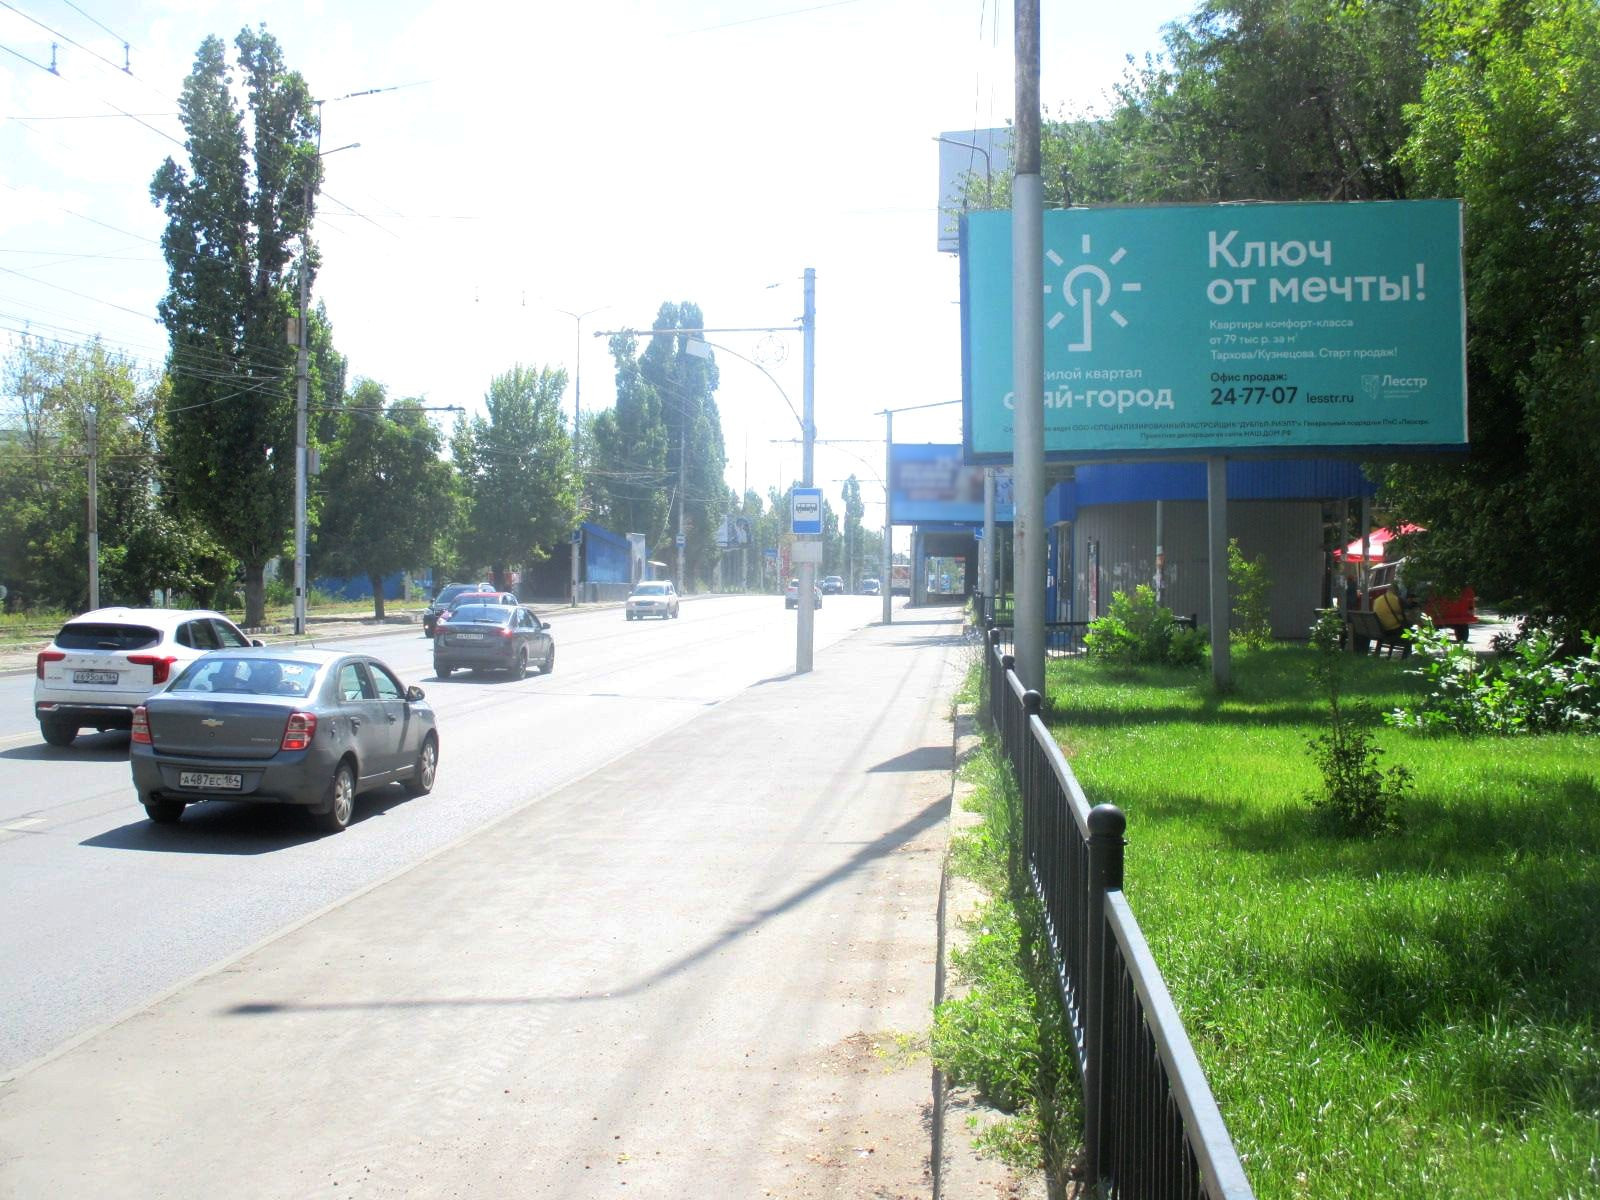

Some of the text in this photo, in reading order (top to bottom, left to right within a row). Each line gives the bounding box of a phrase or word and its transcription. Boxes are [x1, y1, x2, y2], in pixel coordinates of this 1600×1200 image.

[1208, 230, 1332, 268] Ключ
[1207, 263, 1426, 305] от мечты!
[1209, 319, 1354, 331] Квартиры комфорт-класса
[1209, 337, 1222, 345] от
[1224, 334, 1237, 344] 79
[1272, 335, 1285, 343] за
[1210, 347, 1398, 361] Тархова/Кузнецова. Старт продаж!
[1042, 368, 1142, 382] илой квартал
[1210, 372, 1288, 384] Офис продаж:
[1381, 374, 1428, 389] Лесстр
[1003, 385, 1175, 414] сяй-город
[1210, 386, 1354, 405] 24-77-07 lesstr.ru
[224, 775, 240, 785] 164
